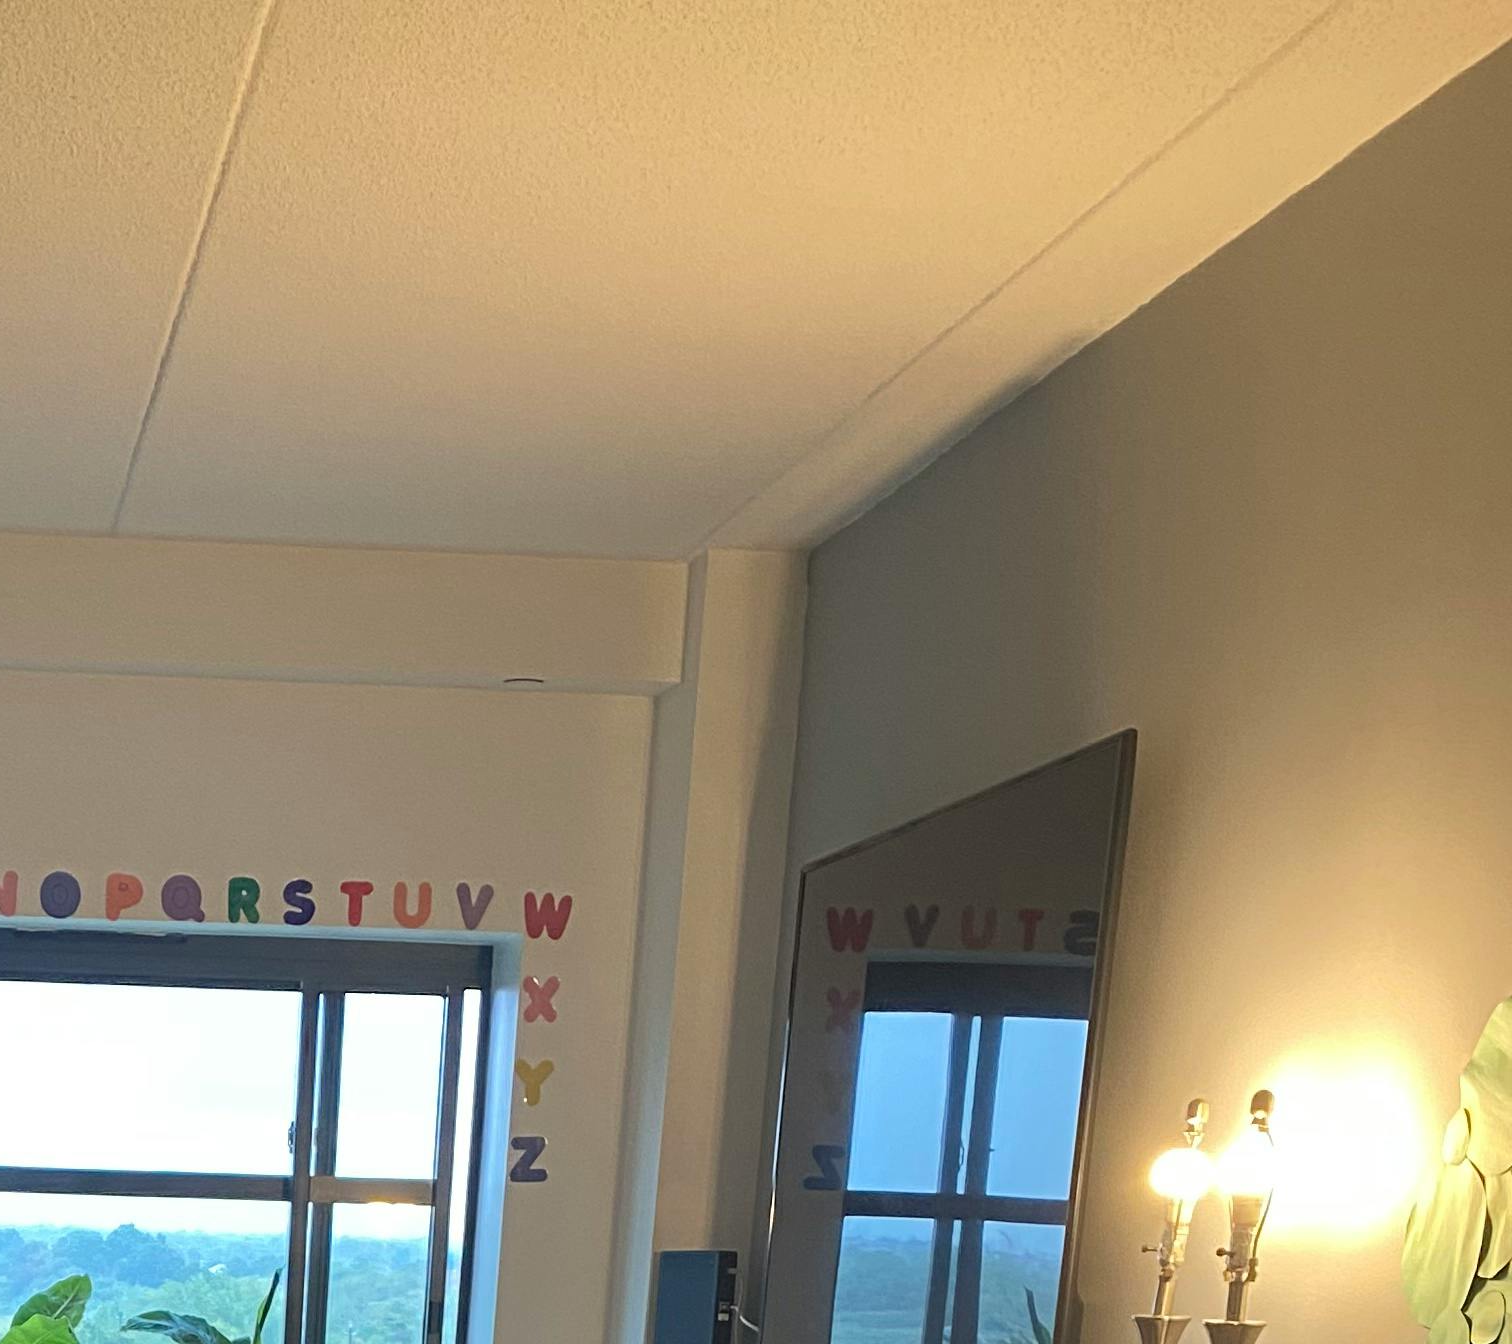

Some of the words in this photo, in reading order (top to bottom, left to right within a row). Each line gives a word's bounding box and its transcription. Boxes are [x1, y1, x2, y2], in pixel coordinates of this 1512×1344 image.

[39, 870, 82, 918] O
[105, 872, 144, 921] P
[161, 874, 206, 923] Q
[227, 876, 261, 924] R
[283, 878, 316, 926] S
[340, 881, 374, 927] T
[393, 881, 433, 928] U
[456, 882, 495, 930] V
[523, 890, 573, 939] W
[522, 975, 561, 1024] X
[515, 1059, 555, 1107] Y
[509, 1136, 548, 1183] Z
